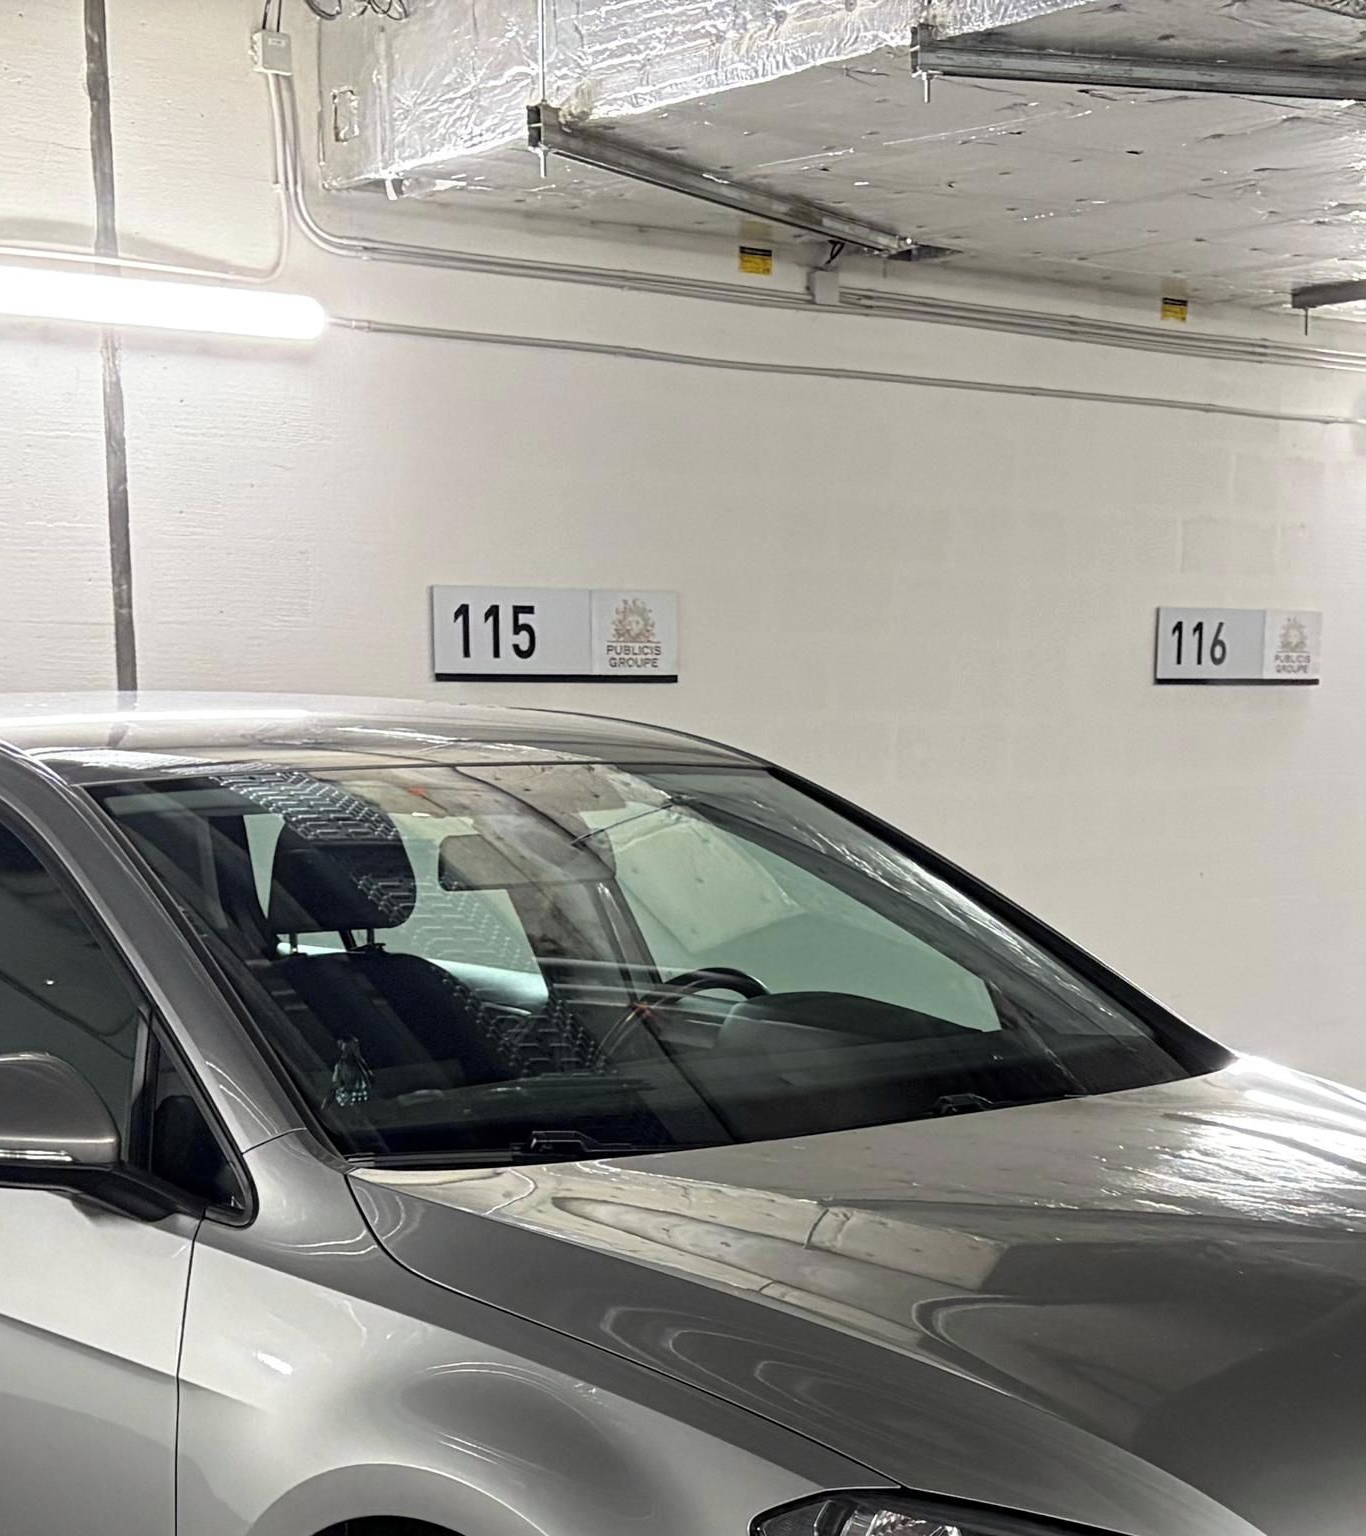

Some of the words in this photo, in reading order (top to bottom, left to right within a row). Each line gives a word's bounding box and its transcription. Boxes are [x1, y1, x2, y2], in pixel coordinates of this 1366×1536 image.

[453, 604, 536, 659] 115
[1171, 621, 1227, 666] 116
[606, 645, 662, 656] PUBLICIS
[609, 657, 659, 668] GROUPE
